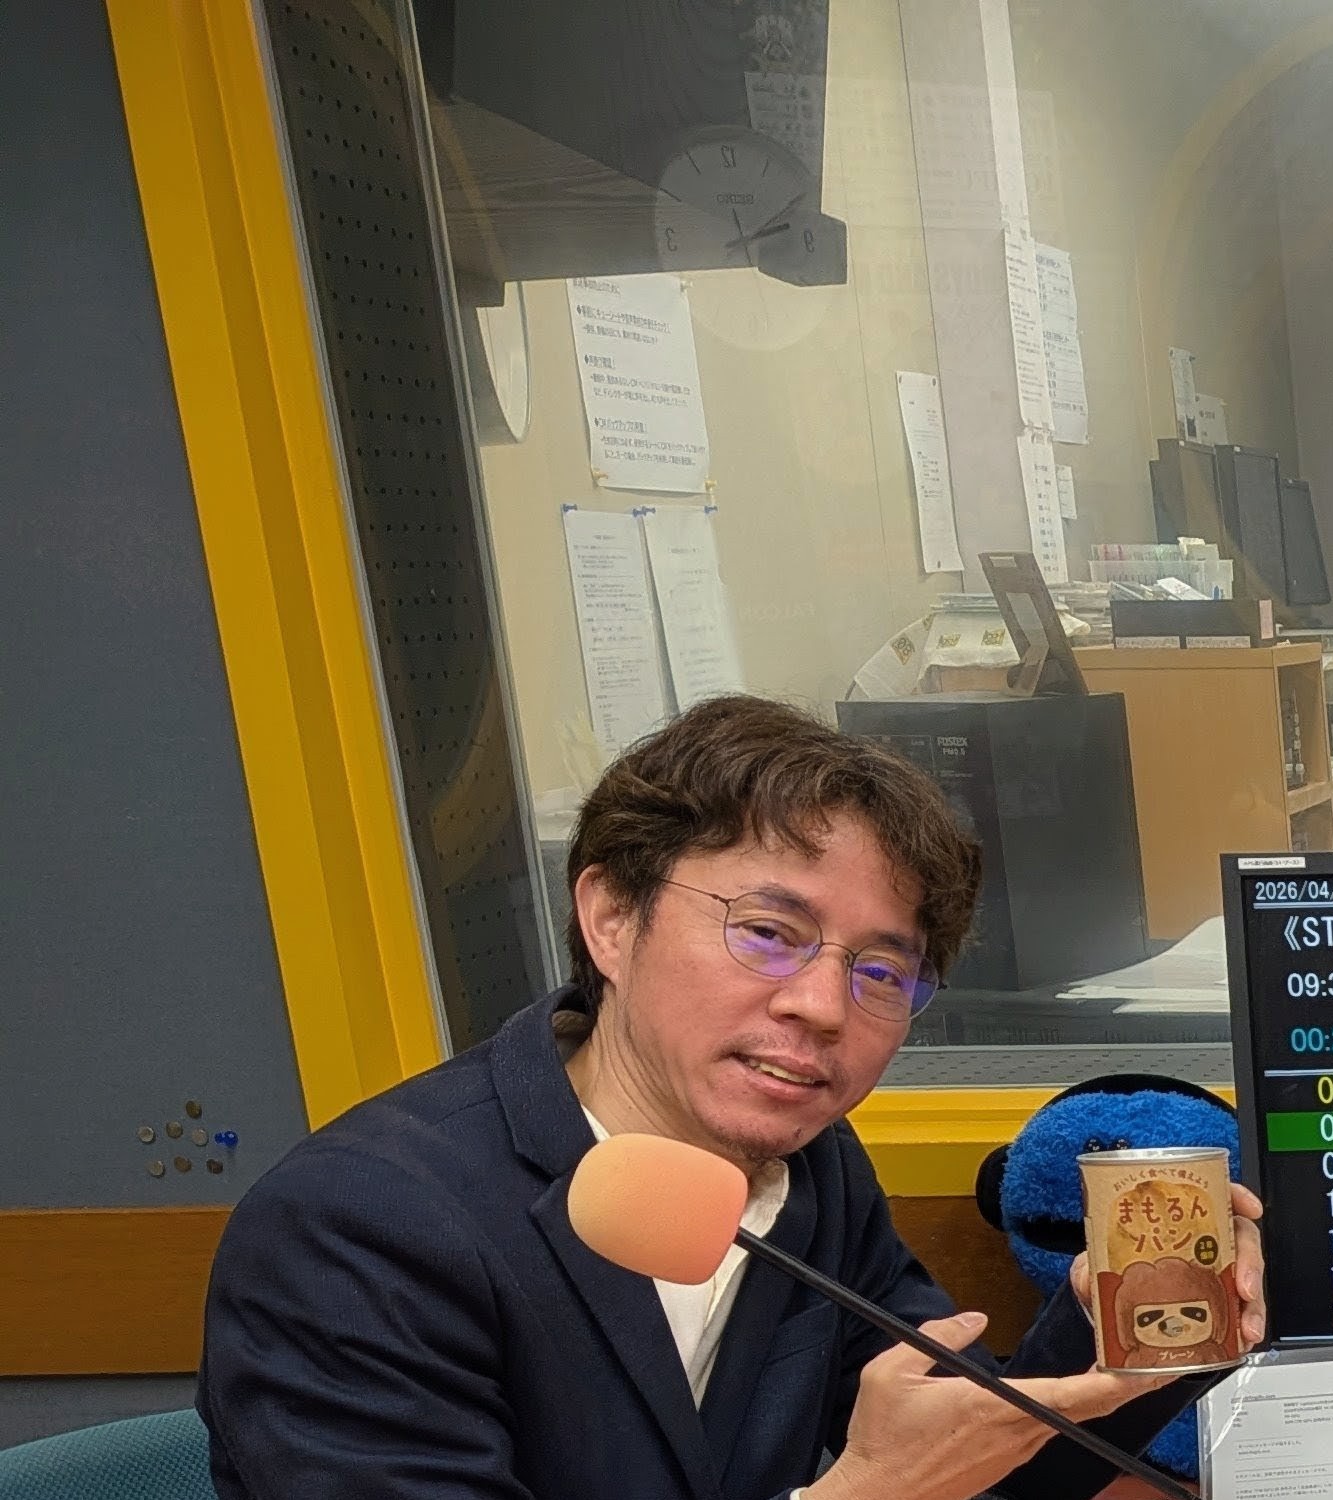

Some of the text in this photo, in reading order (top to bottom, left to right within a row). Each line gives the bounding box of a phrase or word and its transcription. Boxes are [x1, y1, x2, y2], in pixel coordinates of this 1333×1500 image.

[1114, 1168, 1209, 1192] おいしく食べて備えよう
[1118, 1195, 1208, 1225] まもるん
[1134, 1226, 1193, 1253] パン
[1158, 1349, 1195, 1361] プレーン
